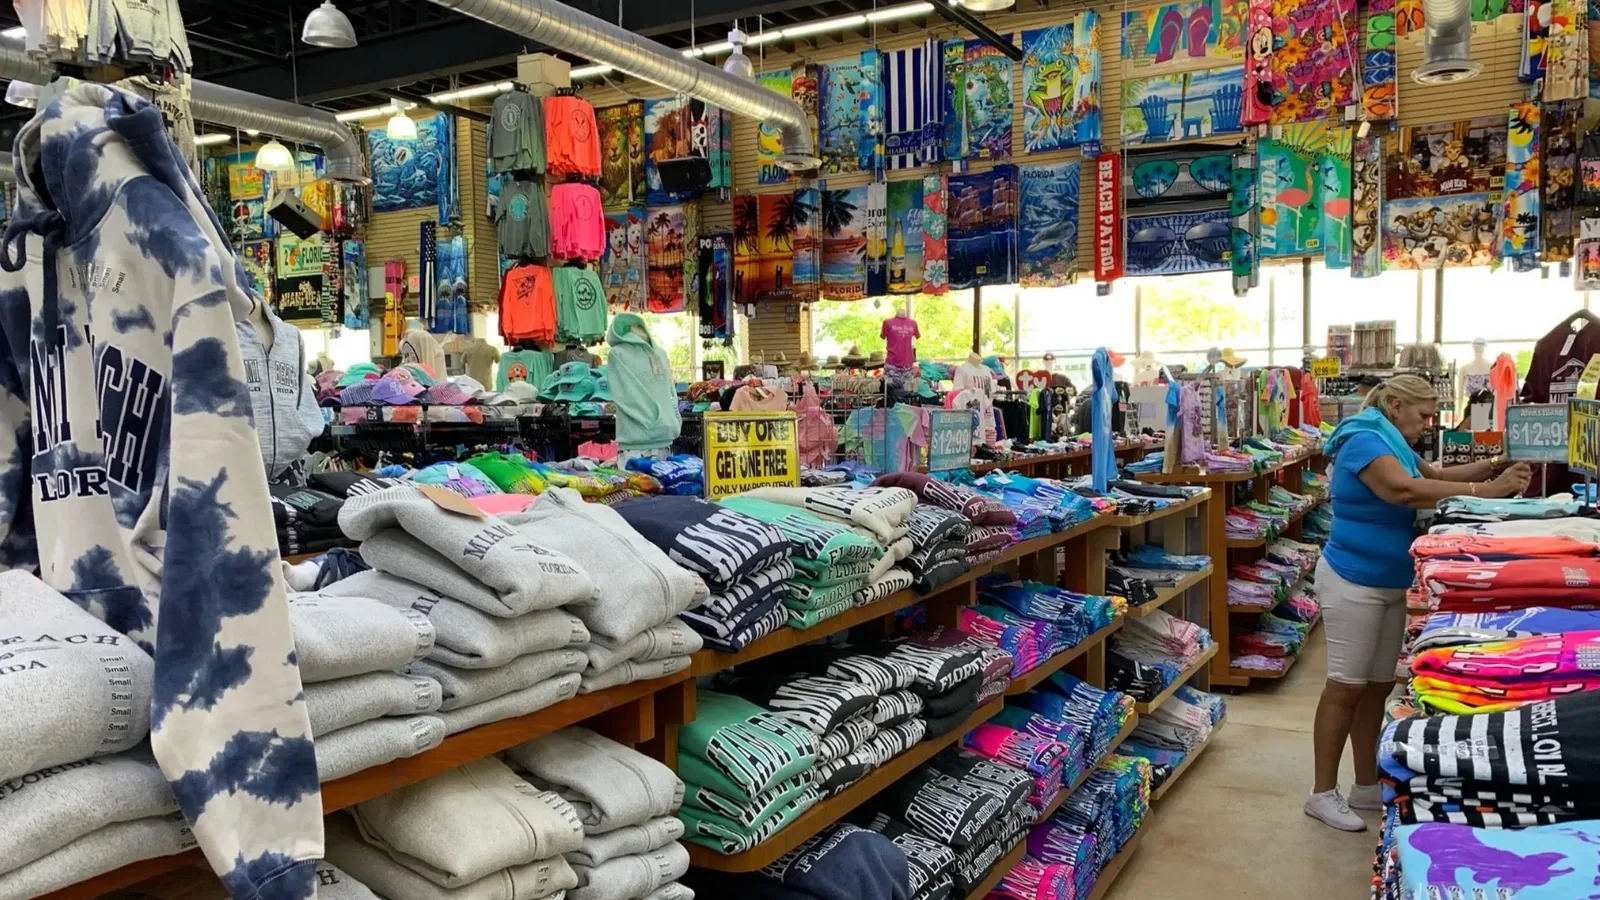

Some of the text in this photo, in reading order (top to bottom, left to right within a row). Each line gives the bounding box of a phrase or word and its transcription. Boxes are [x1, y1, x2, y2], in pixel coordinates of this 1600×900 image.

[1271, 139, 1320, 159] Sunshine
[1023, 170, 1055, 180] FLORIDA
[1261, 158, 1277, 250] FLRIDA
[1098, 159, 1114, 276] BEACH PATROL
[112, 271, 126, 293] Small
[716, 420, 790, 443] BUY ONE
[932, 428, 970, 455] $12.99
[715, 447, 788, 480] GET ONE FREE
[712, 484, 737, 495] ONLY
[863, 487, 914, 515] FLORIDA
[538, 561, 579, 575] FLORIDA
[104, 666, 130, 674] Small
[109, 678, 132, 687] Small
[111, 692, 133, 701] Small
[110, 707, 132, 717] Small
[108, 723, 129, 732] Small
